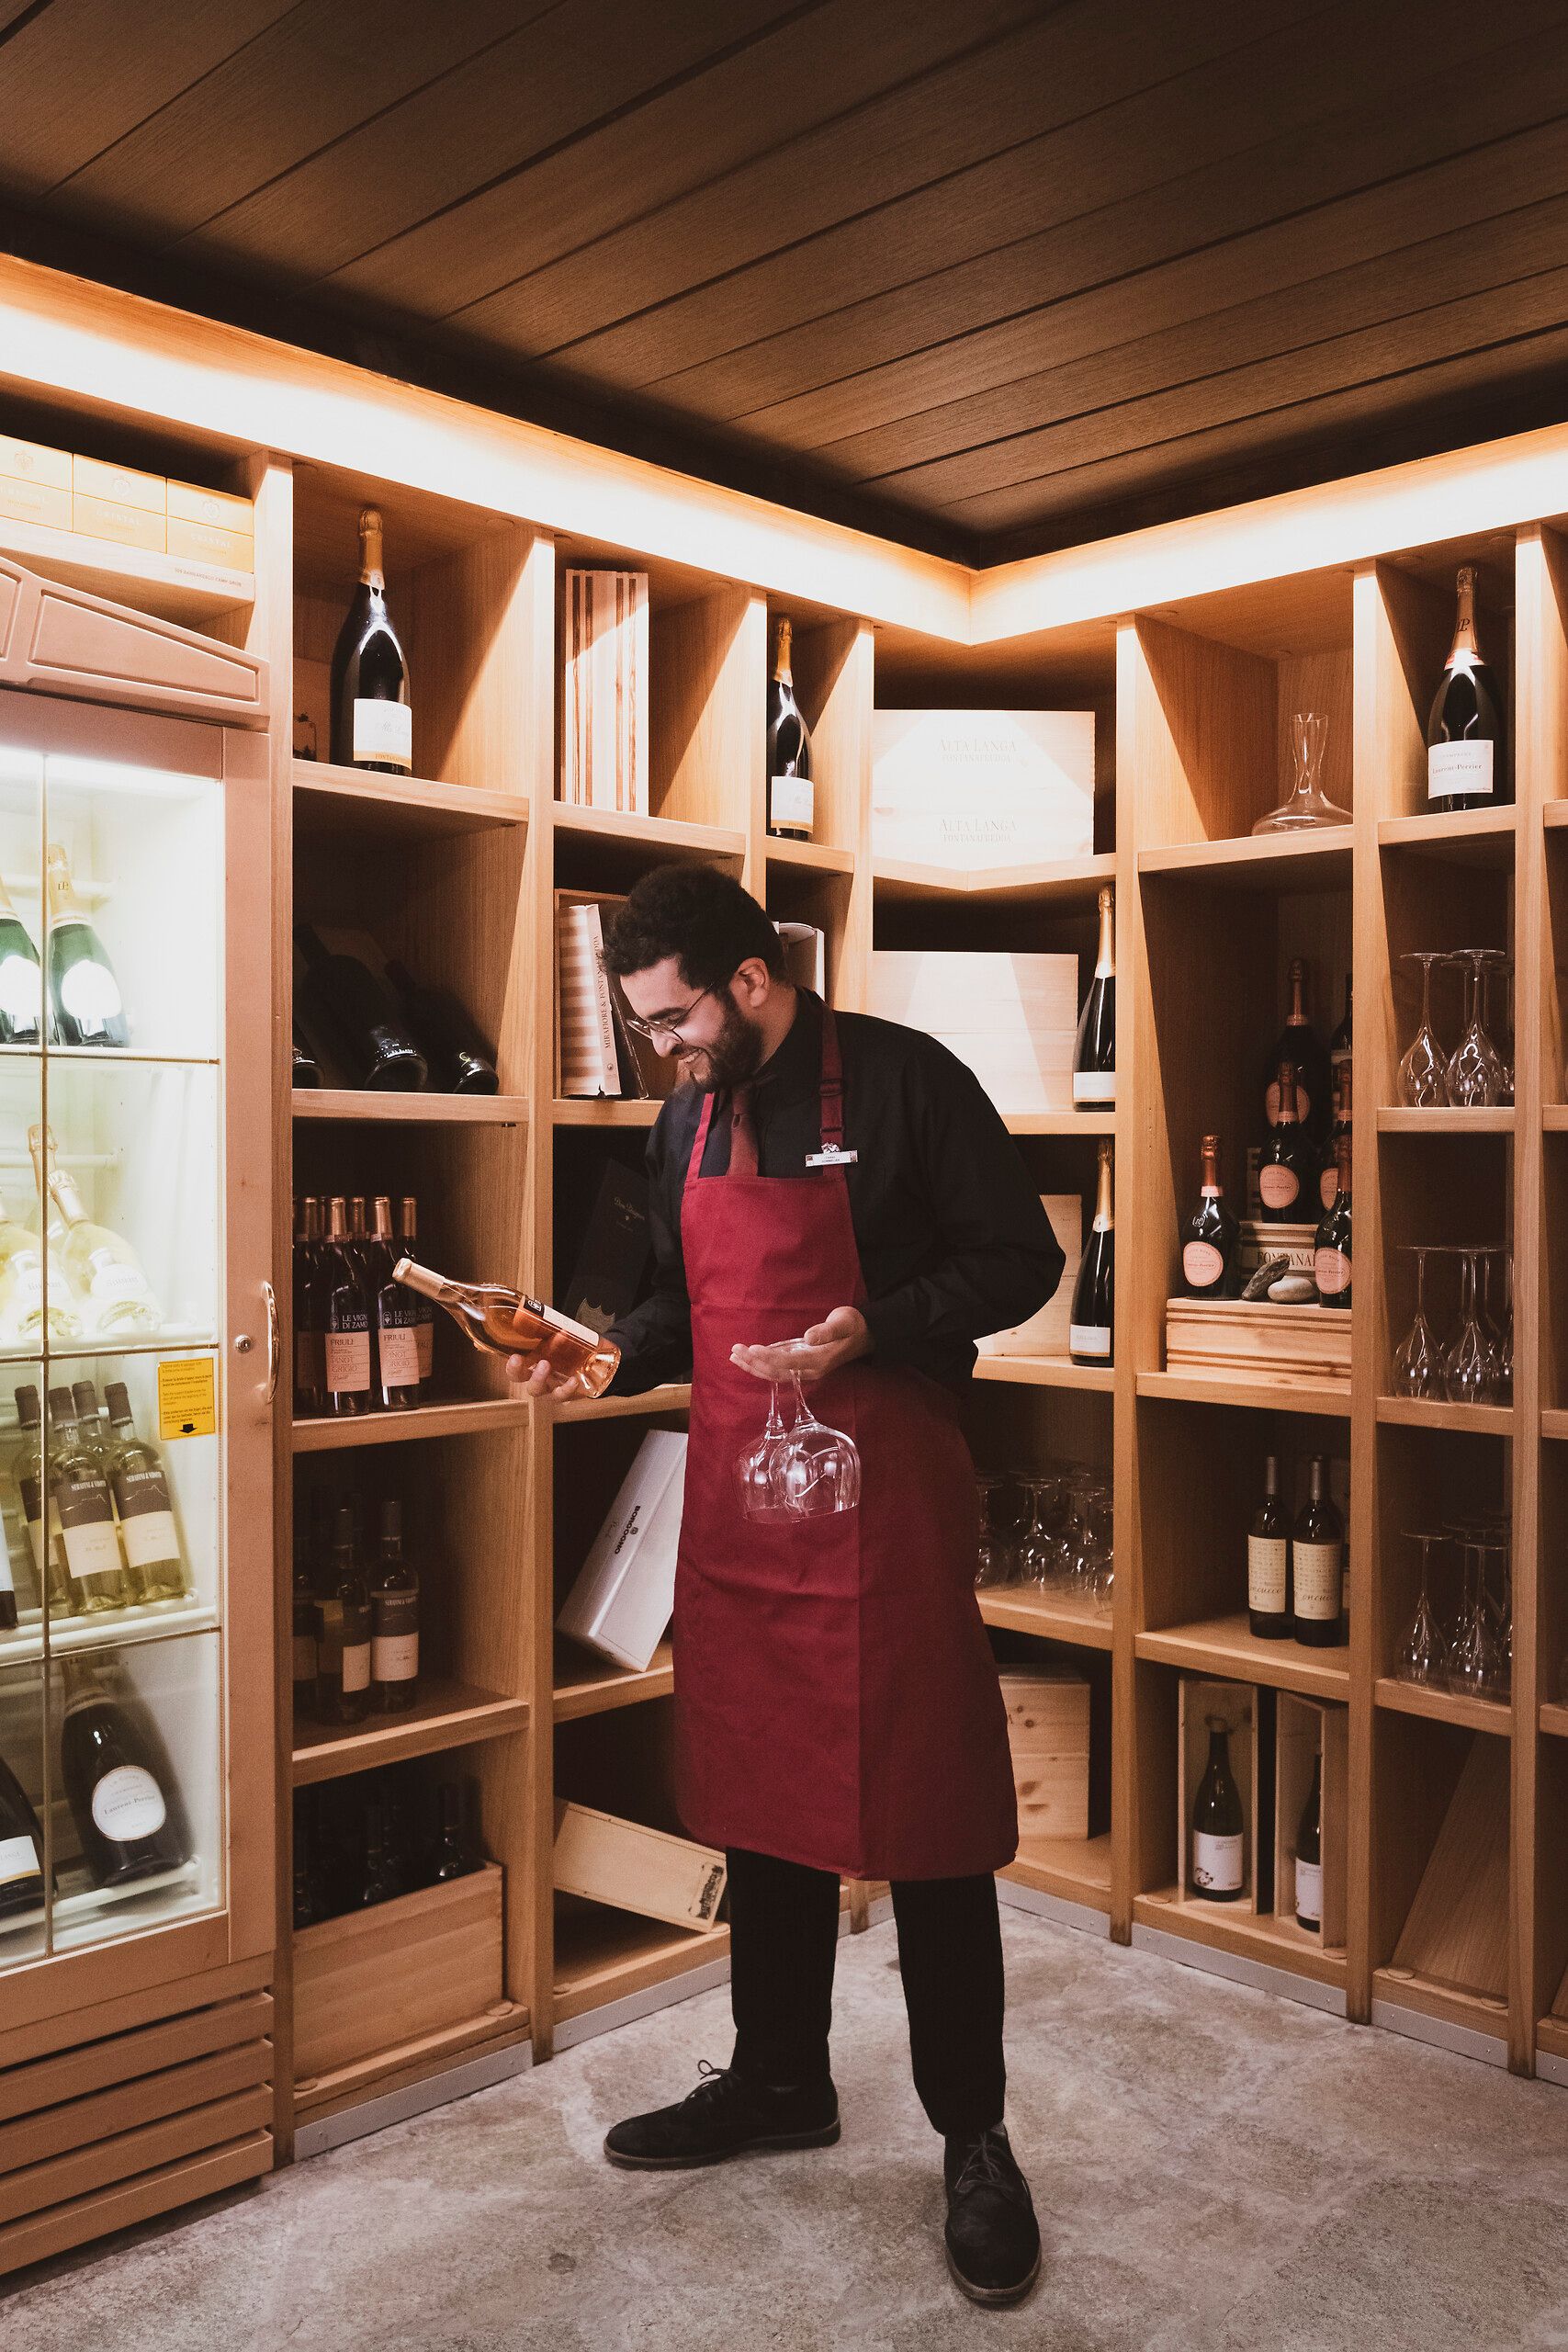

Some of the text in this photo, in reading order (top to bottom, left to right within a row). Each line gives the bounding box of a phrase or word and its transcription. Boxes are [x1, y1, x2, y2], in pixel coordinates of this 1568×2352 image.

[601, 1009, 611, 1049] MIRAFIORE
[343, 1315, 352, 1323] LE
[615, 1506, 641, 1555] BORGOGNO
